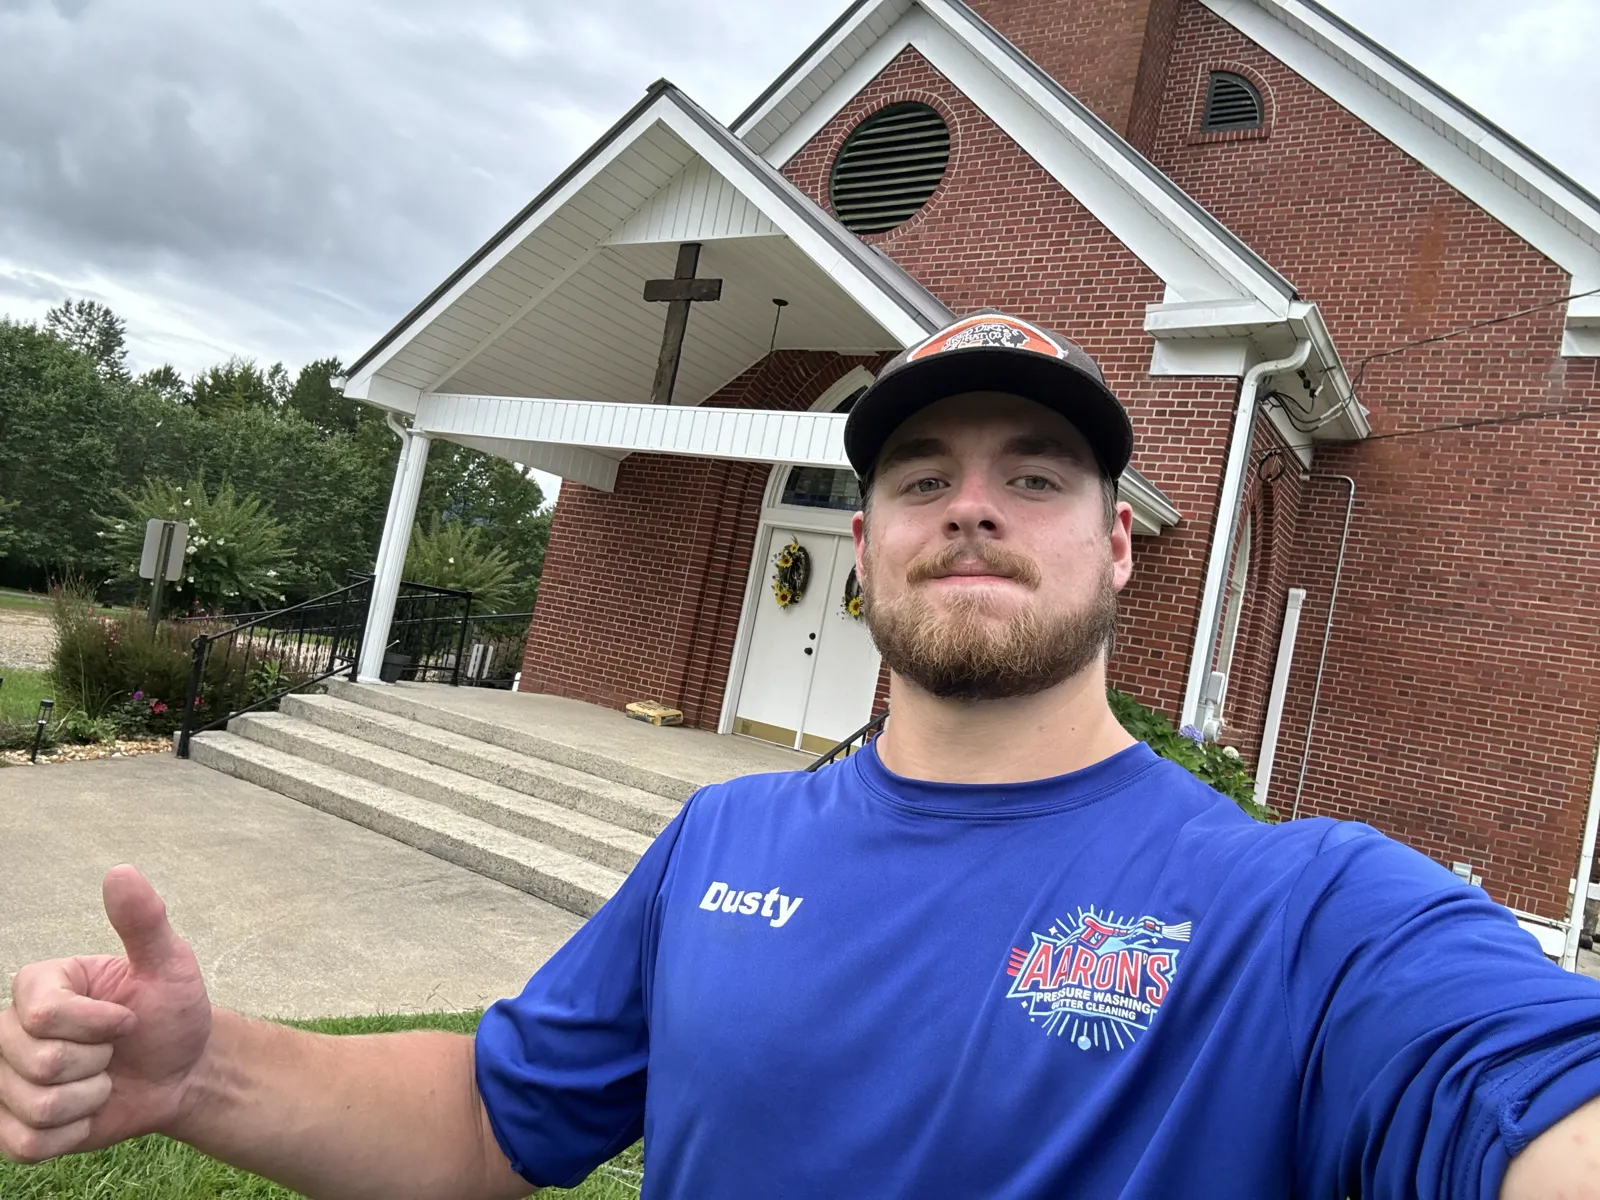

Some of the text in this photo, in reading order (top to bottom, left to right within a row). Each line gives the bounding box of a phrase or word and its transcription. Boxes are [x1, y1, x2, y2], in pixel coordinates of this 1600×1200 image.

[699, 881, 804, 928] Dusty
[1017, 941, 1169, 1007] AARON'S
[1036, 987, 1151, 1014] PRESSURE WASHING
[1086, 1001, 1136, 1020] CLEANING
